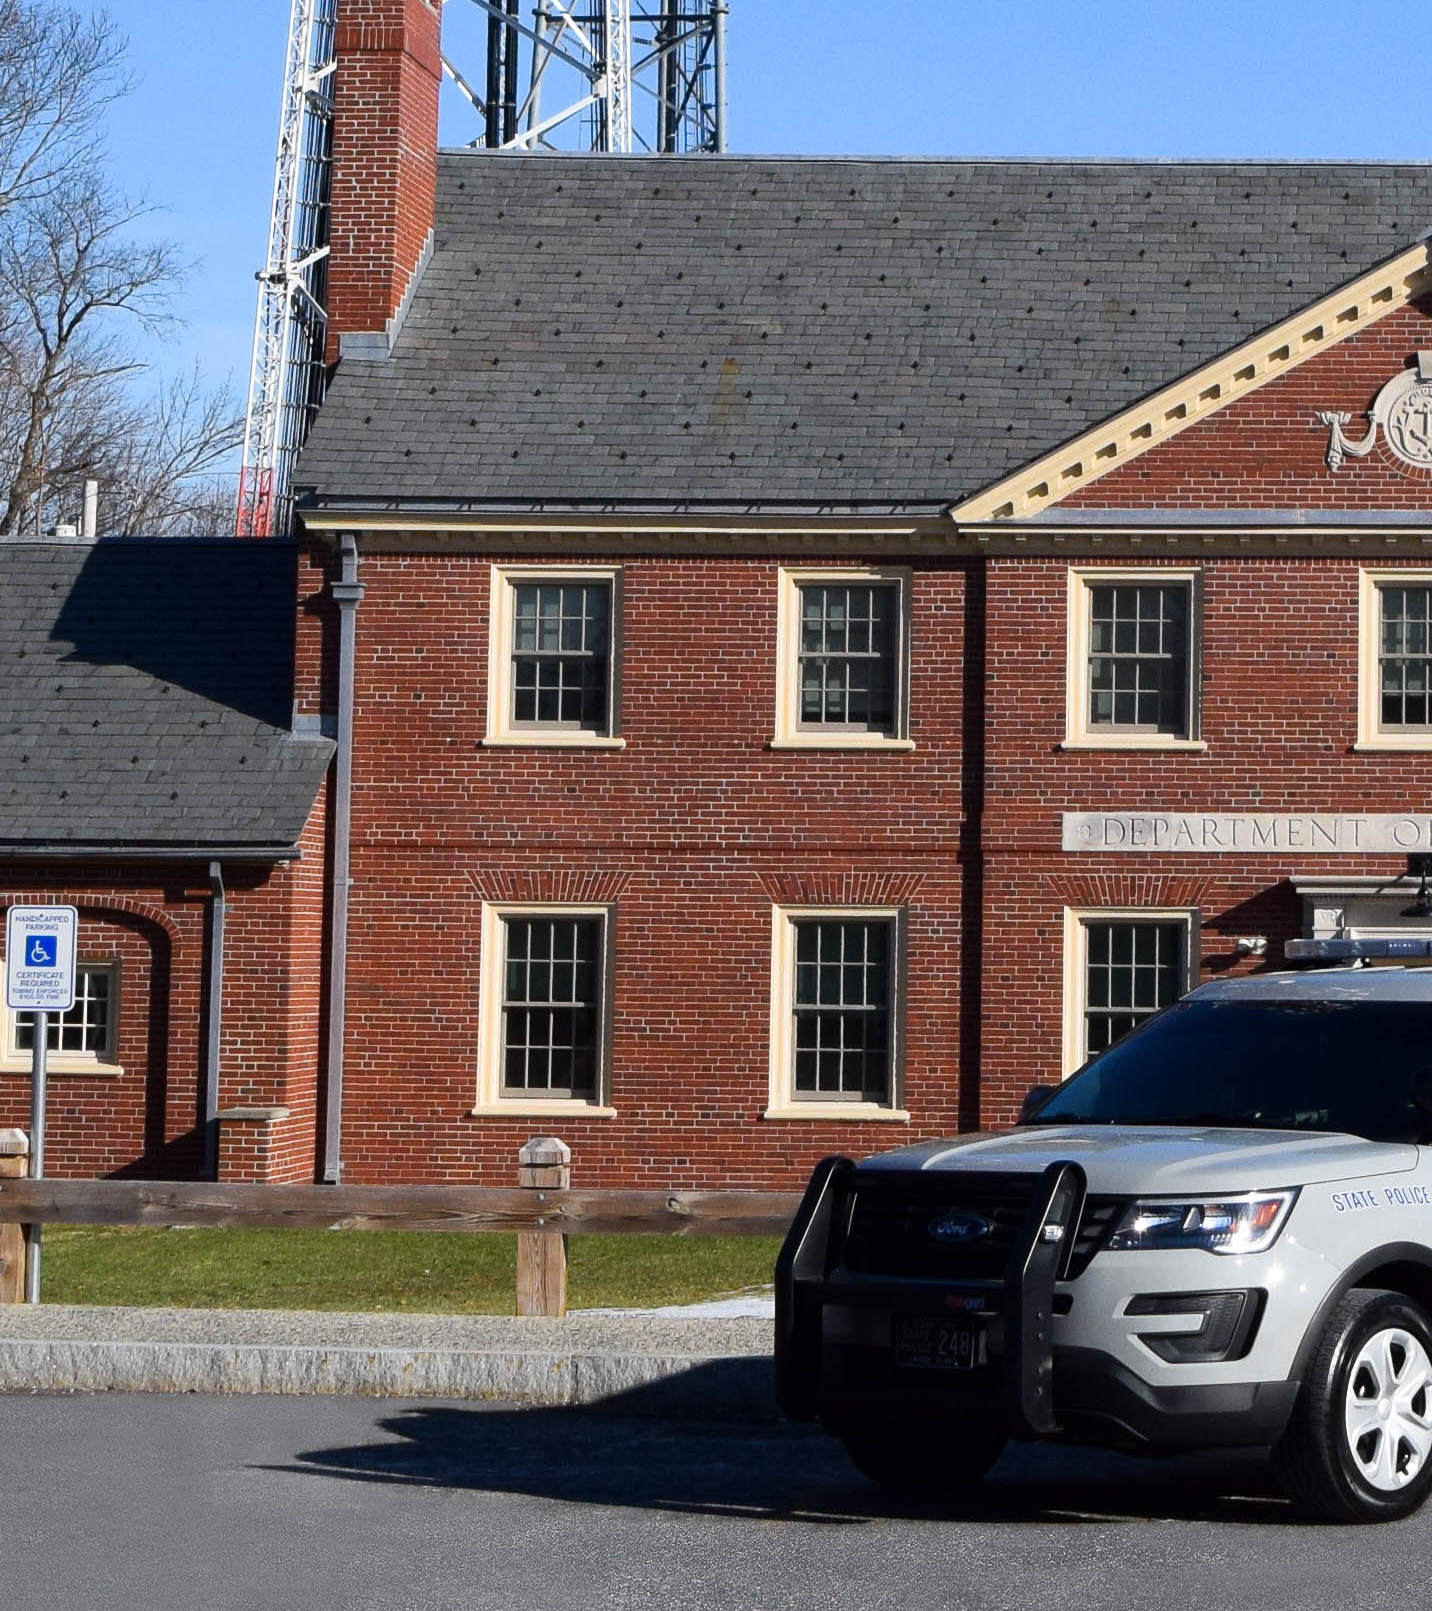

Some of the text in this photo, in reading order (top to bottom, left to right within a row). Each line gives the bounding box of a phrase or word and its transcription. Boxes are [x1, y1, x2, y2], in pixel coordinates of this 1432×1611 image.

[1102, 818, 1367, 846] DEPARTMENT
[1332, 1186, 1431, 1211] STATE POLICE
[937, 1330, 969, 1356] 248
